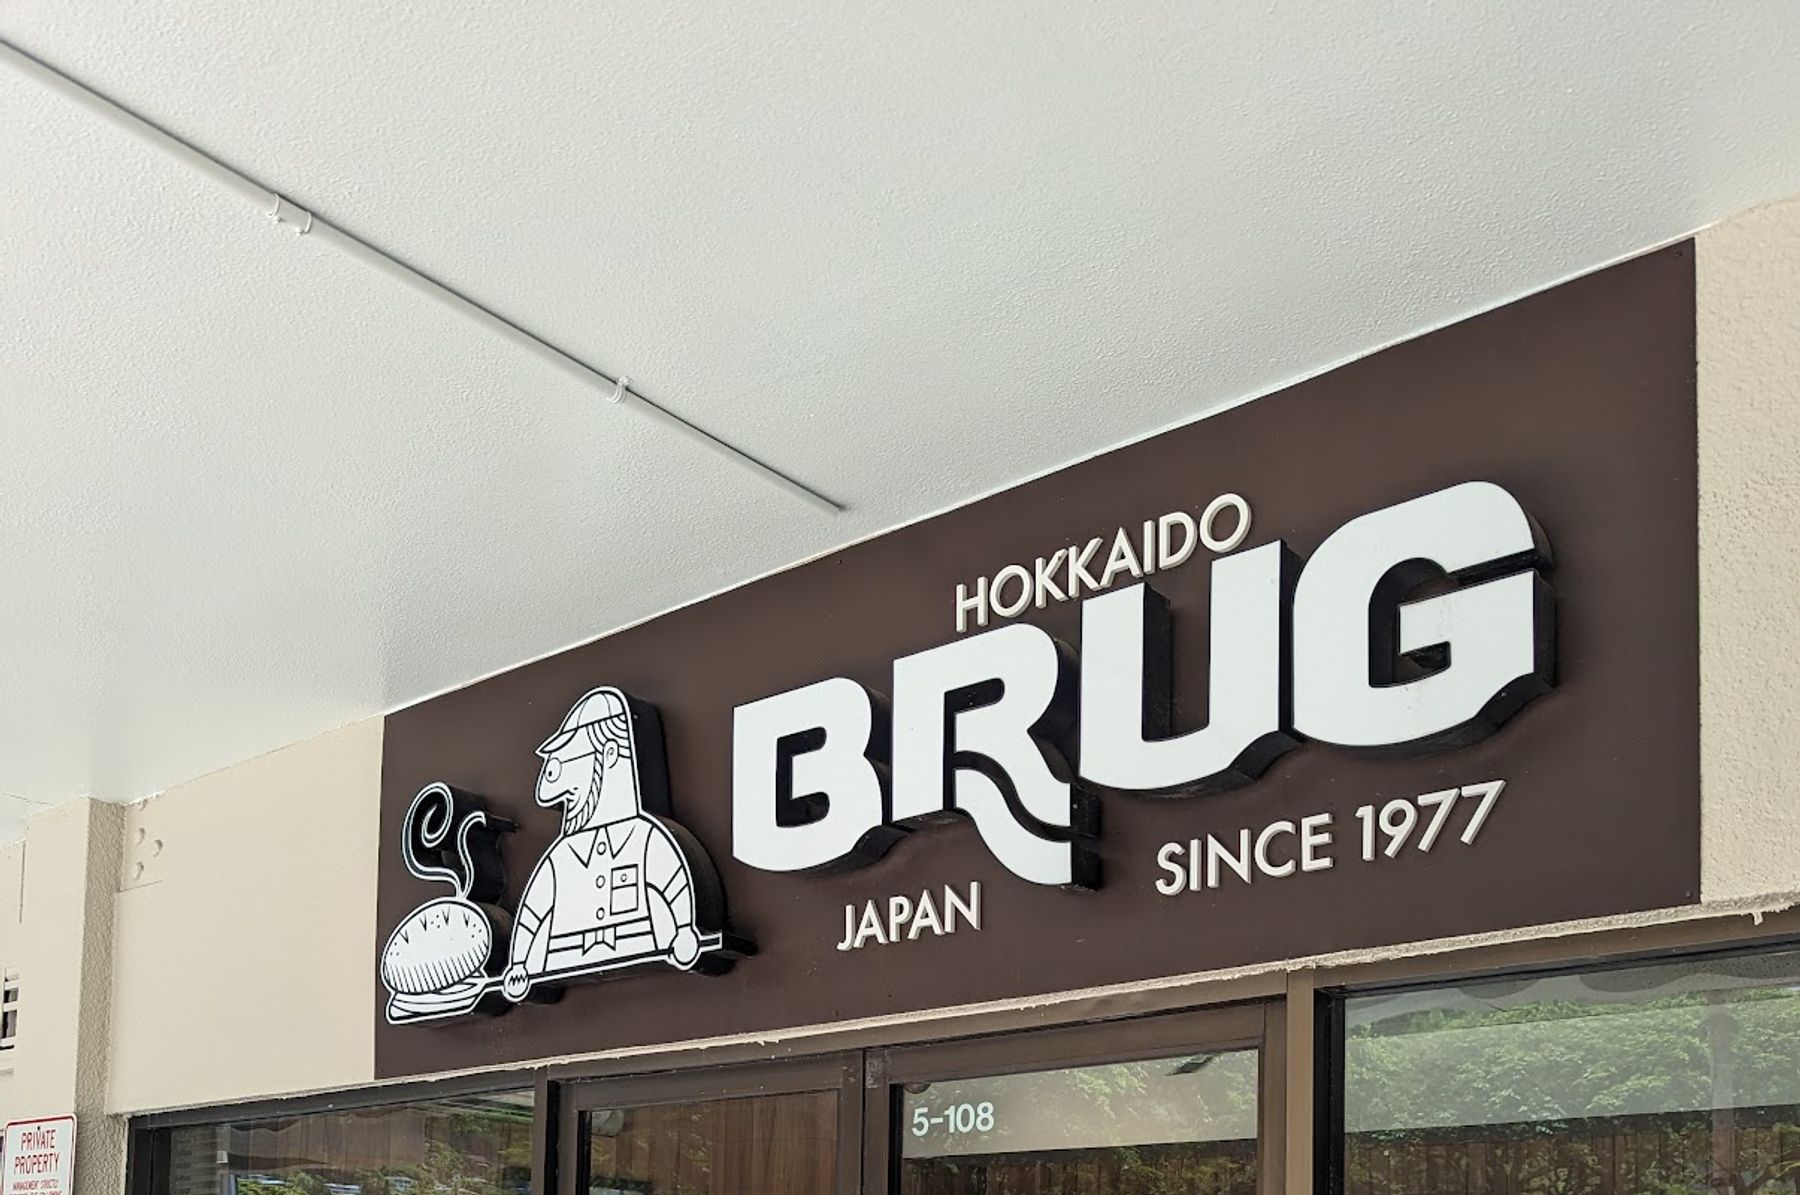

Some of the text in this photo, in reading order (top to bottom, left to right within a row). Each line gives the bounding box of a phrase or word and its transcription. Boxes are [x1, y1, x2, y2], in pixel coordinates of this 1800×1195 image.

[953, 492, 1253, 633] HOKKAIDO
[732, 480, 1536, 887] BRUG
[1155, 780, 1507, 897] SINCE 1977
[836, 881, 983, 952] JAPAN
[21, 1129, 56, 1151] PRIVATE
[911, 1101, 995, 1137] 5-108
[14, 1152, 60, 1175] PROPERTY
